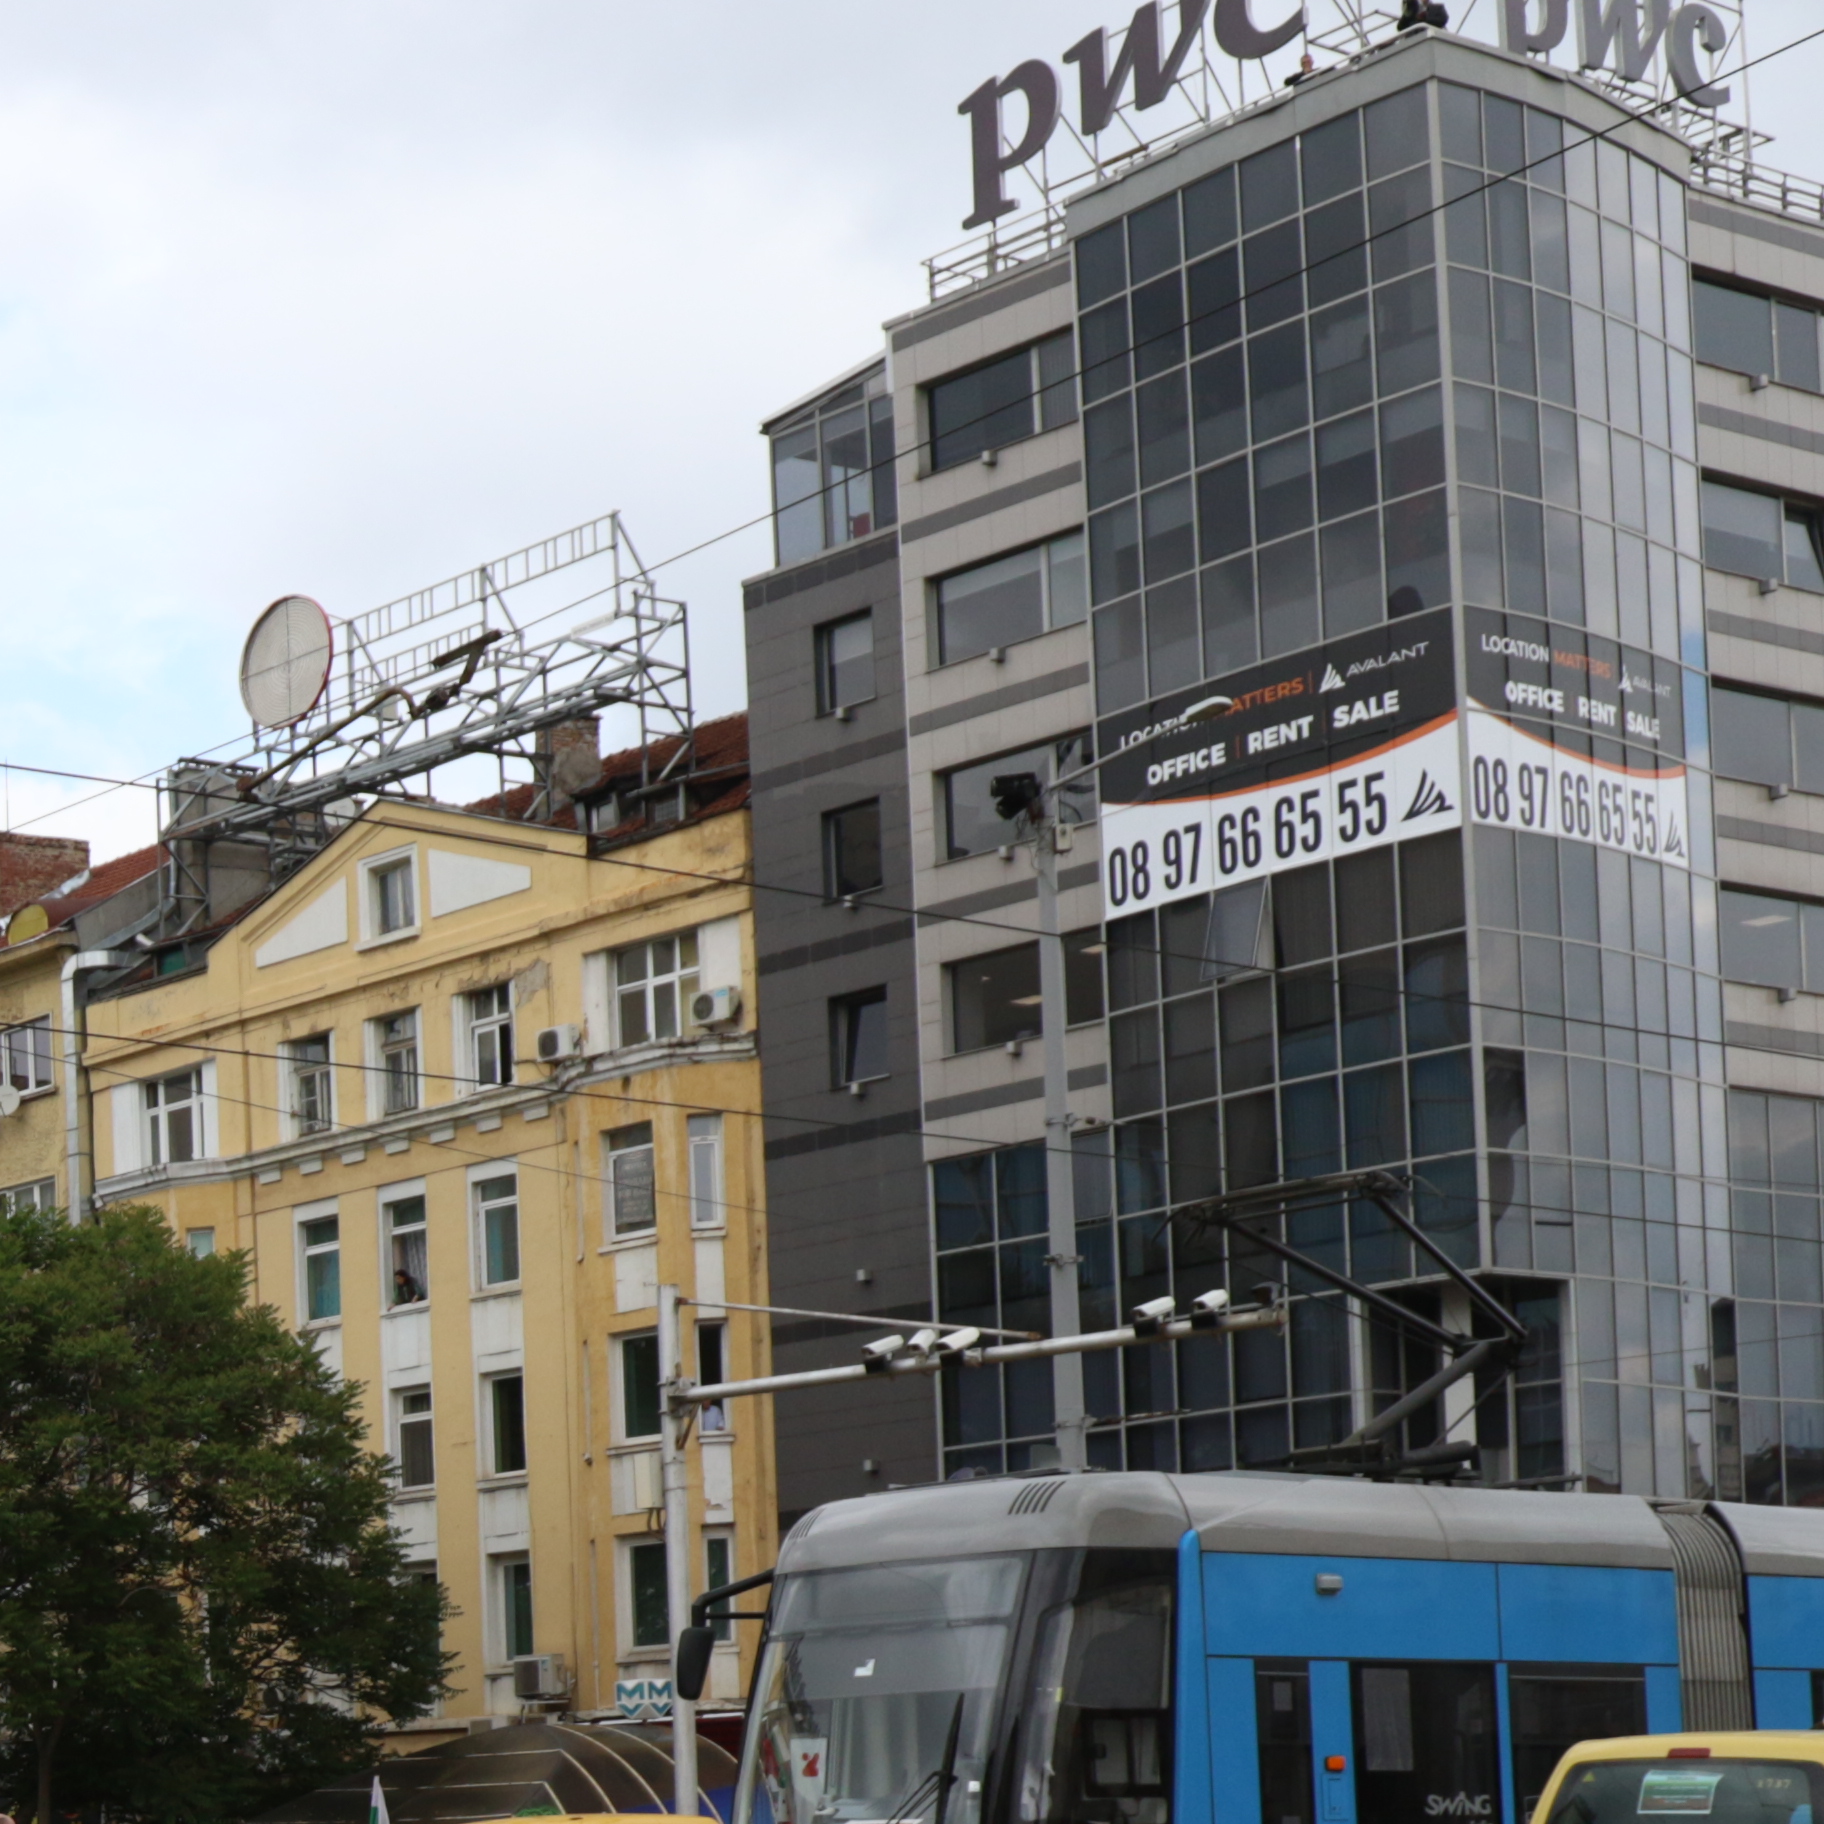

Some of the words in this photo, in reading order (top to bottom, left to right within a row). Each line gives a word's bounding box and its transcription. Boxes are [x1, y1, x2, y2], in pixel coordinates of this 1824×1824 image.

[957, 0, 1309, 230] pwc
[1346, 641, 1429, 678] AVALANT
[1481, 633, 1550, 663] LOCATION
[1554, 649, 1612, 679] MATTERS
[1147, 743, 1227, 786] OFFICE
[1247, 714, 1315, 755] RENT
[1332, 689, 1400, 730] SALE
[1504, 680, 1565, 713] OFFICE
[1577, 696, 1617, 727] RENT
[1626, 710, 1661, 740] SALE
[1108, 839, 1151, 907] 08
[1162, 821, 1203, 890] 97
[1216, 805, 1263, 876] 66
[1273, 788, 1323, 859] 65
[1337, 770, 1387, 843] 55
[1473, 755, 1510, 822] 08
[1518, 762, 1549, 829] 97
[1560, 770, 1591, 837] 66
[1598, 779, 1626, 847] 65
[1631, 788, 1658, 855] 55
